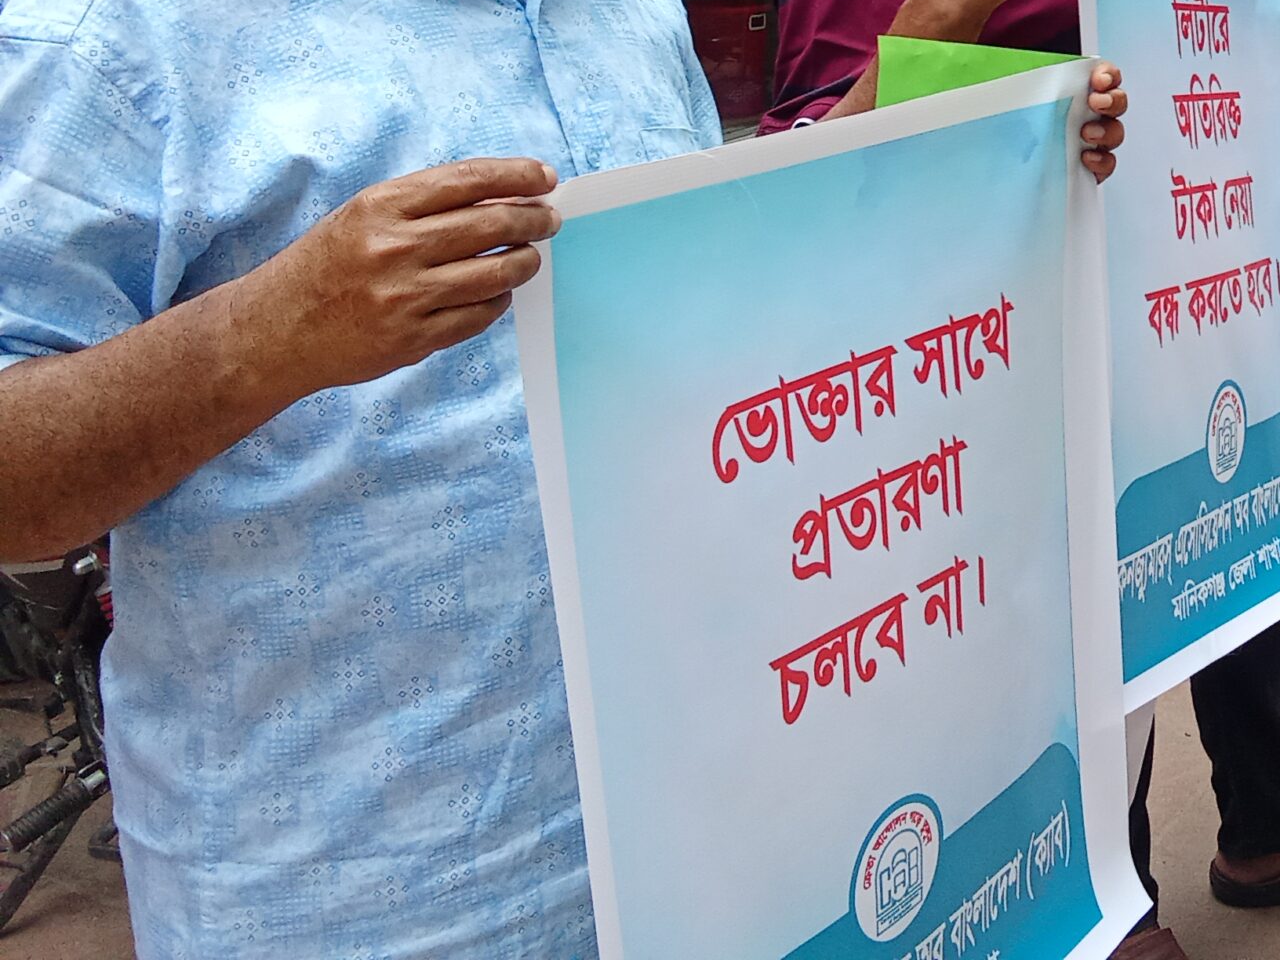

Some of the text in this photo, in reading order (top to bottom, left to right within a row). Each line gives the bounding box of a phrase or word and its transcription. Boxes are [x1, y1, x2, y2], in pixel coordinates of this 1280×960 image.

[1171, 73, 1242, 150] অতিরিক্ত
[1170, 168, 1254, 244] টাকা নেয়া
[1145, 285, 1181, 349] বন্ধ
[1185, 268, 1243, 337] করতে
[712, 292, 1015, 483] ভোক্তার সাথে
[792, 435, 968, 581] প্রতারণা
[770, 592, 909, 726] চলবে
[949, 848, 1023, 957] বাংলাদেশ
[1026, 800, 1071, 900] (ক্যাব)
